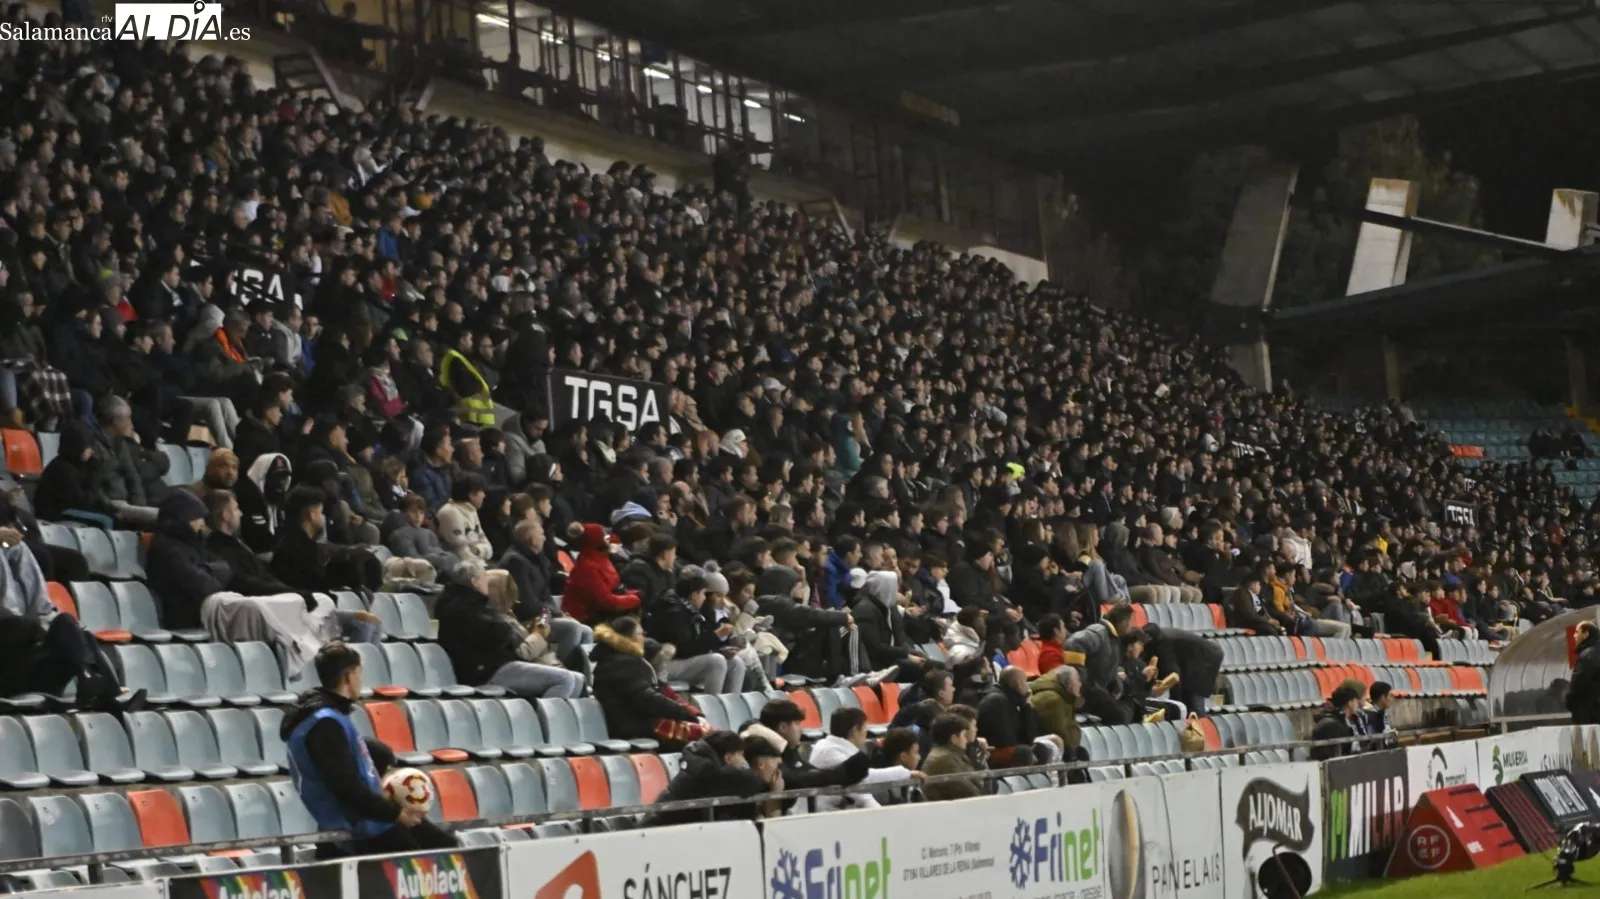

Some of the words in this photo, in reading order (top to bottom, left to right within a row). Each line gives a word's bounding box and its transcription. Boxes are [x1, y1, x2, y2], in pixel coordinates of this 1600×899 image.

[564, 375, 660, 431] TGSA
[1249, 792, 1303, 842] ALJOMAR
[1033, 807, 1100, 883] Frinet
[396, 861, 468, 899] Autolack
[623, 862, 732, 899] SÁNCHEZ
